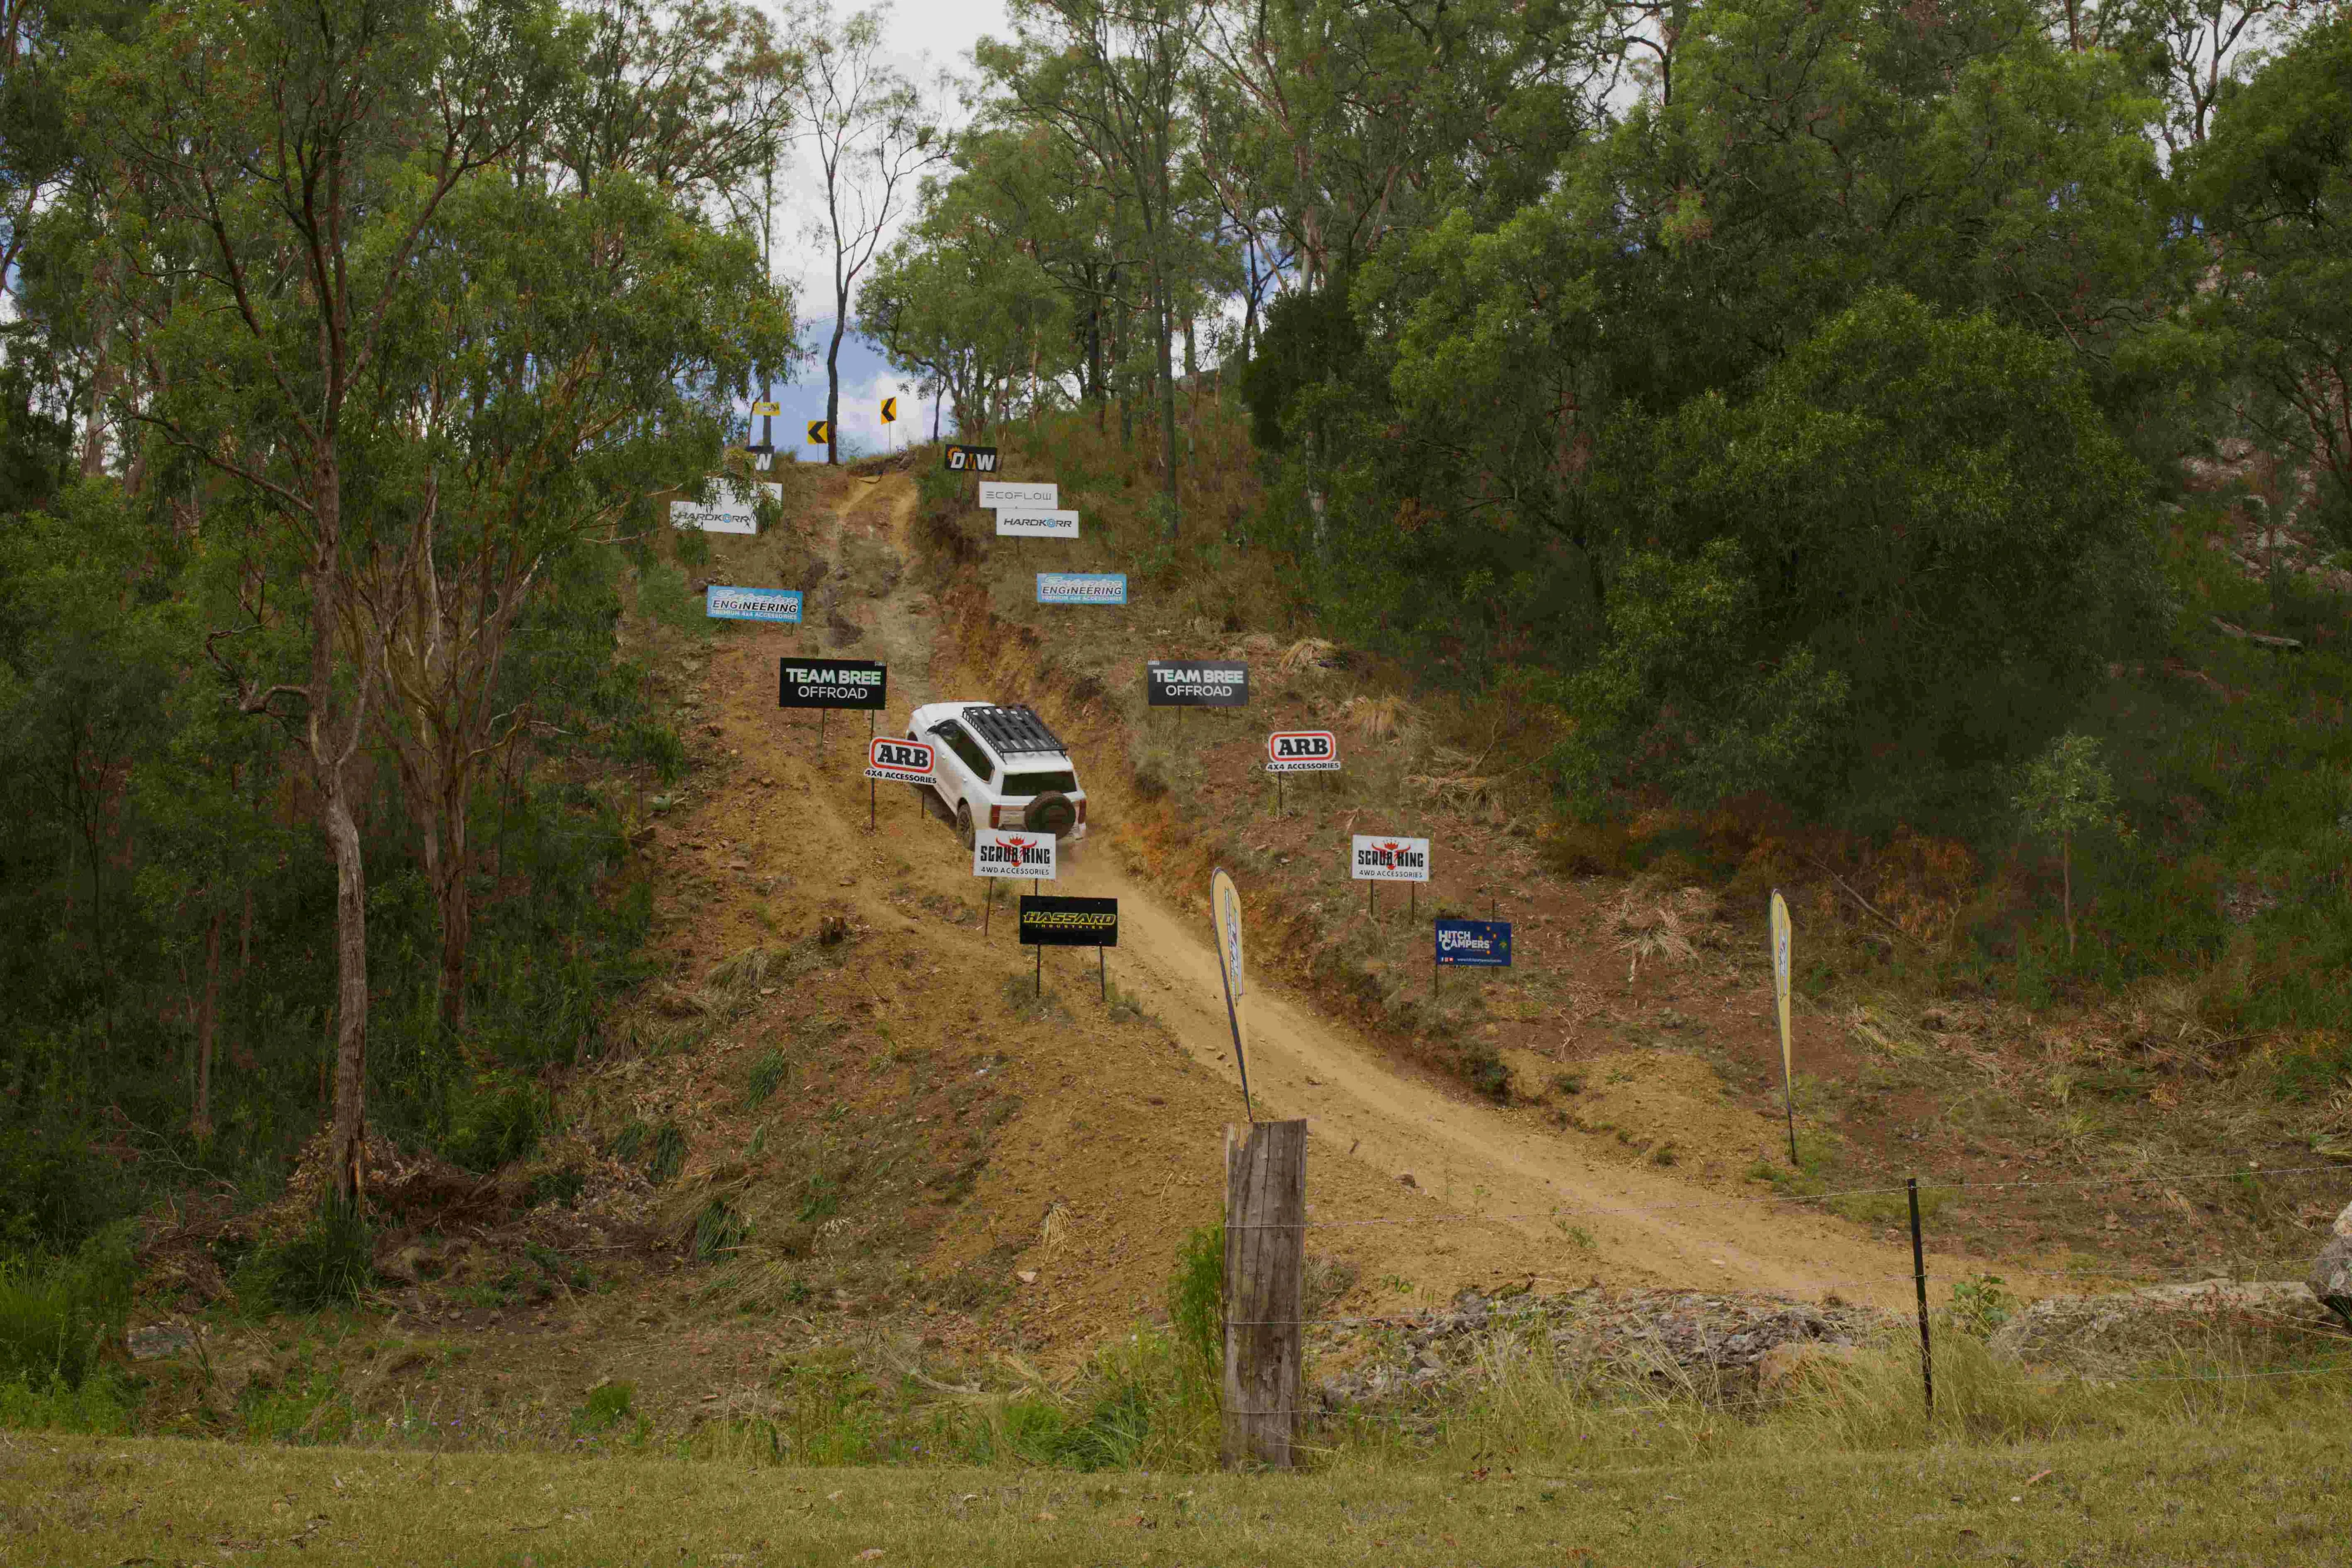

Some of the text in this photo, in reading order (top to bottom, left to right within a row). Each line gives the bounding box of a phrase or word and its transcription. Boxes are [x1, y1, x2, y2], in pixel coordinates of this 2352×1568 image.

[985, 491, 1052, 500] ECOFLOW
[1004, 518, 1072, 528] HARDKORR
[786, 668, 881, 686] TEAM BREE
[1152, 669, 1244, 684] TEAM BREE
[798, 686, 868, 699] OFFROAD
[1165, 685, 1232, 697] OFFROAD
[1278, 738, 1328, 755] ARB
[877, 744, 928, 767] ARB
[884, 772, 937, 784] ACCESSORIES
[980, 845, 1050, 864] SCRUB KING
[1358, 850, 1424, 867] SCRUB KING
[1000, 867, 1050, 875] ACCESSORIES
[1023, 911, 1117, 925] HASSARD
[1438, 930, 1471, 942] HITCH
[1441, 938, 1490, 951] CAMPERS
